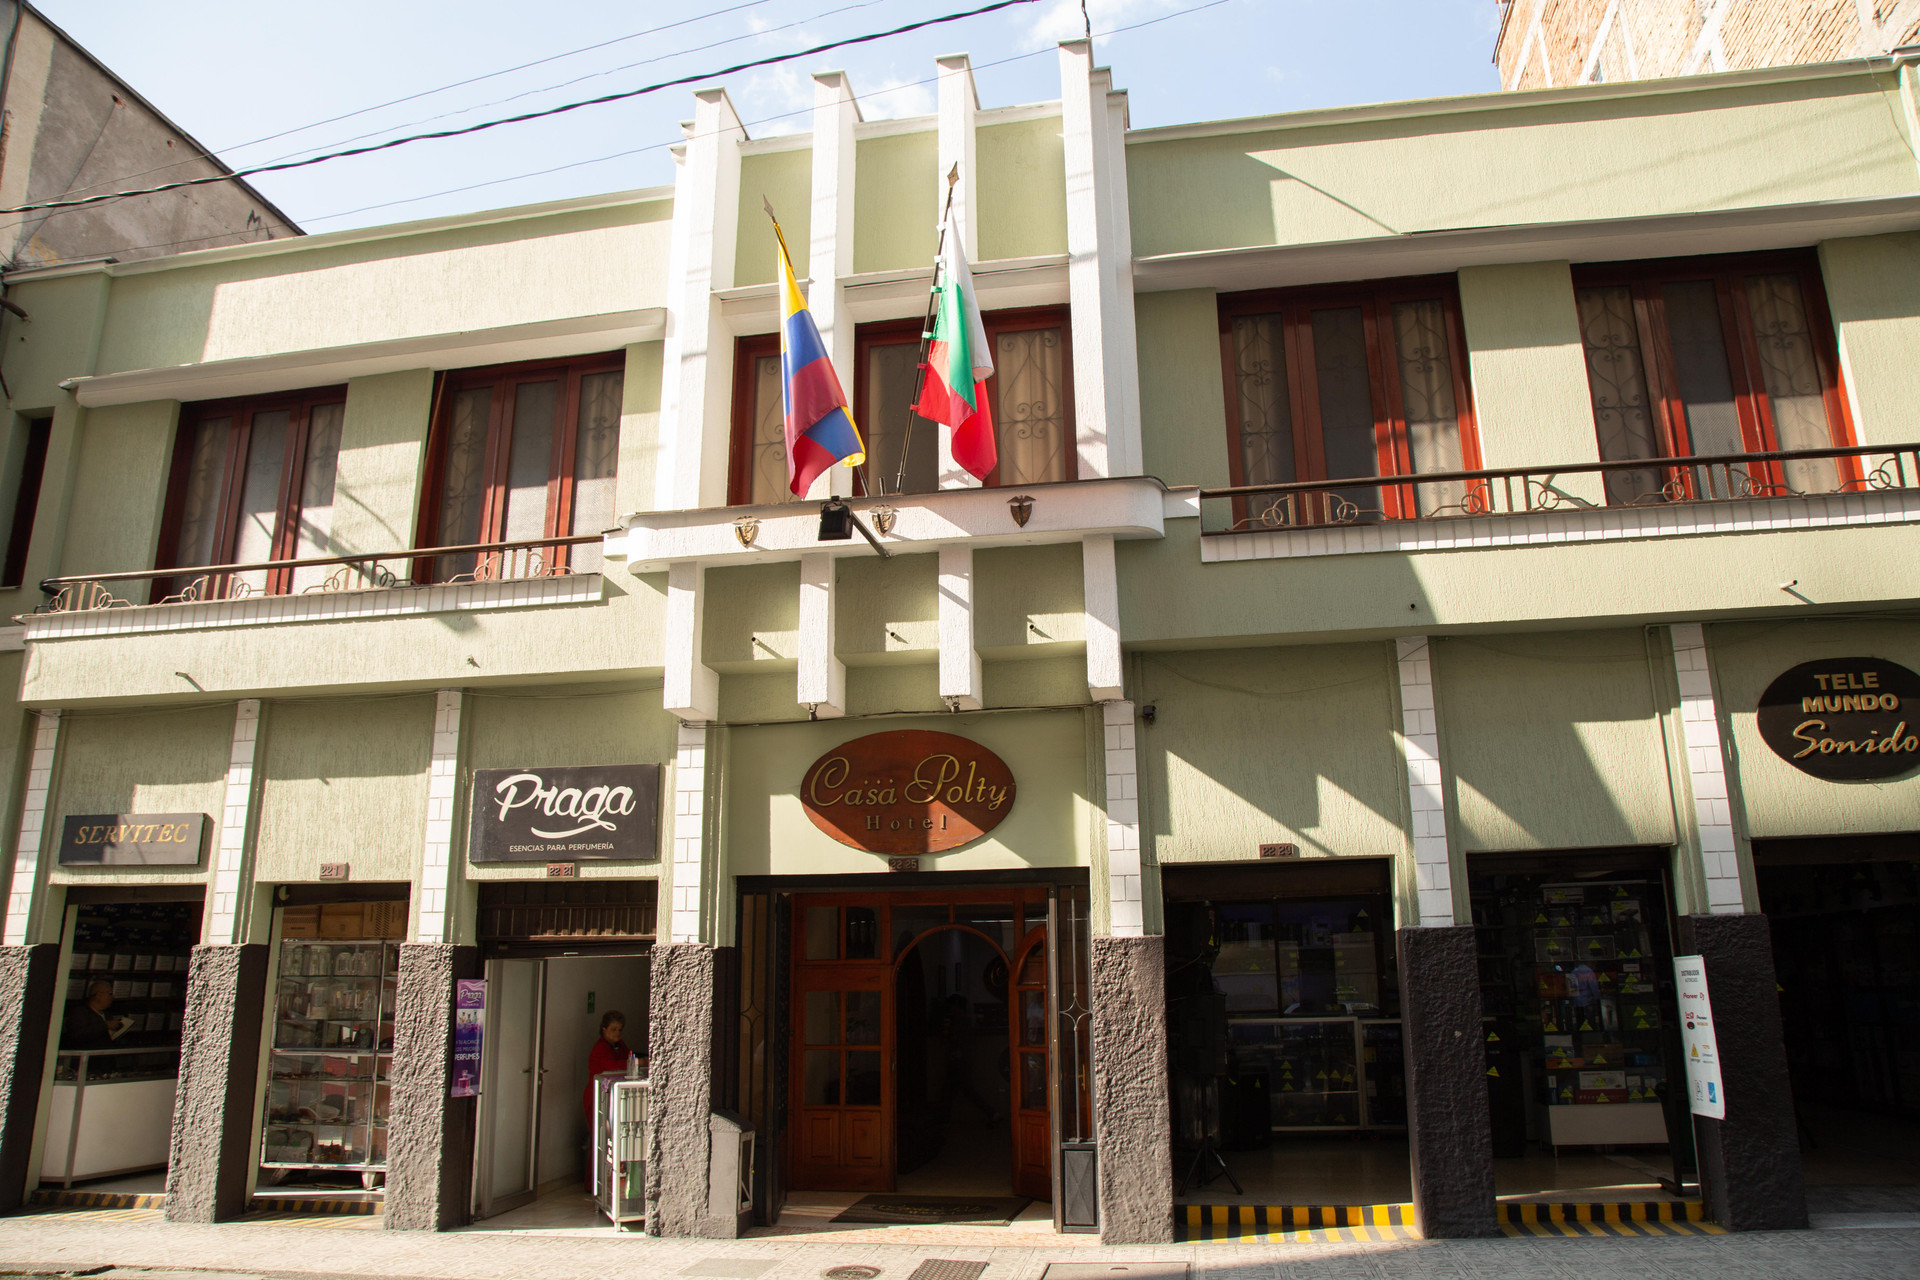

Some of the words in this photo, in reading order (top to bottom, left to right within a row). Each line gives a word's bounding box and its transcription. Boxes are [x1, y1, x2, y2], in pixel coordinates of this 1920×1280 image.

[1814, 672, 1880, 691] TELE
[1802, 693, 1900, 713] MUNDO
[1793, 719, 1919, 759] Sonido
[810, 757, 898, 807] Casa
[904, 754, 1007, 811] Polty
[494, 773, 637, 839] Praga
[866, 813, 948, 831] Hotel
[75, 823, 190, 845] SERVITEC
[509, 844, 545, 852] ESENCIAS
[546, 843, 567, 851] PARA
[568, 842, 615, 851] PERFUMERÍA
[1682, 992, 1699, 1000] Pioneer
